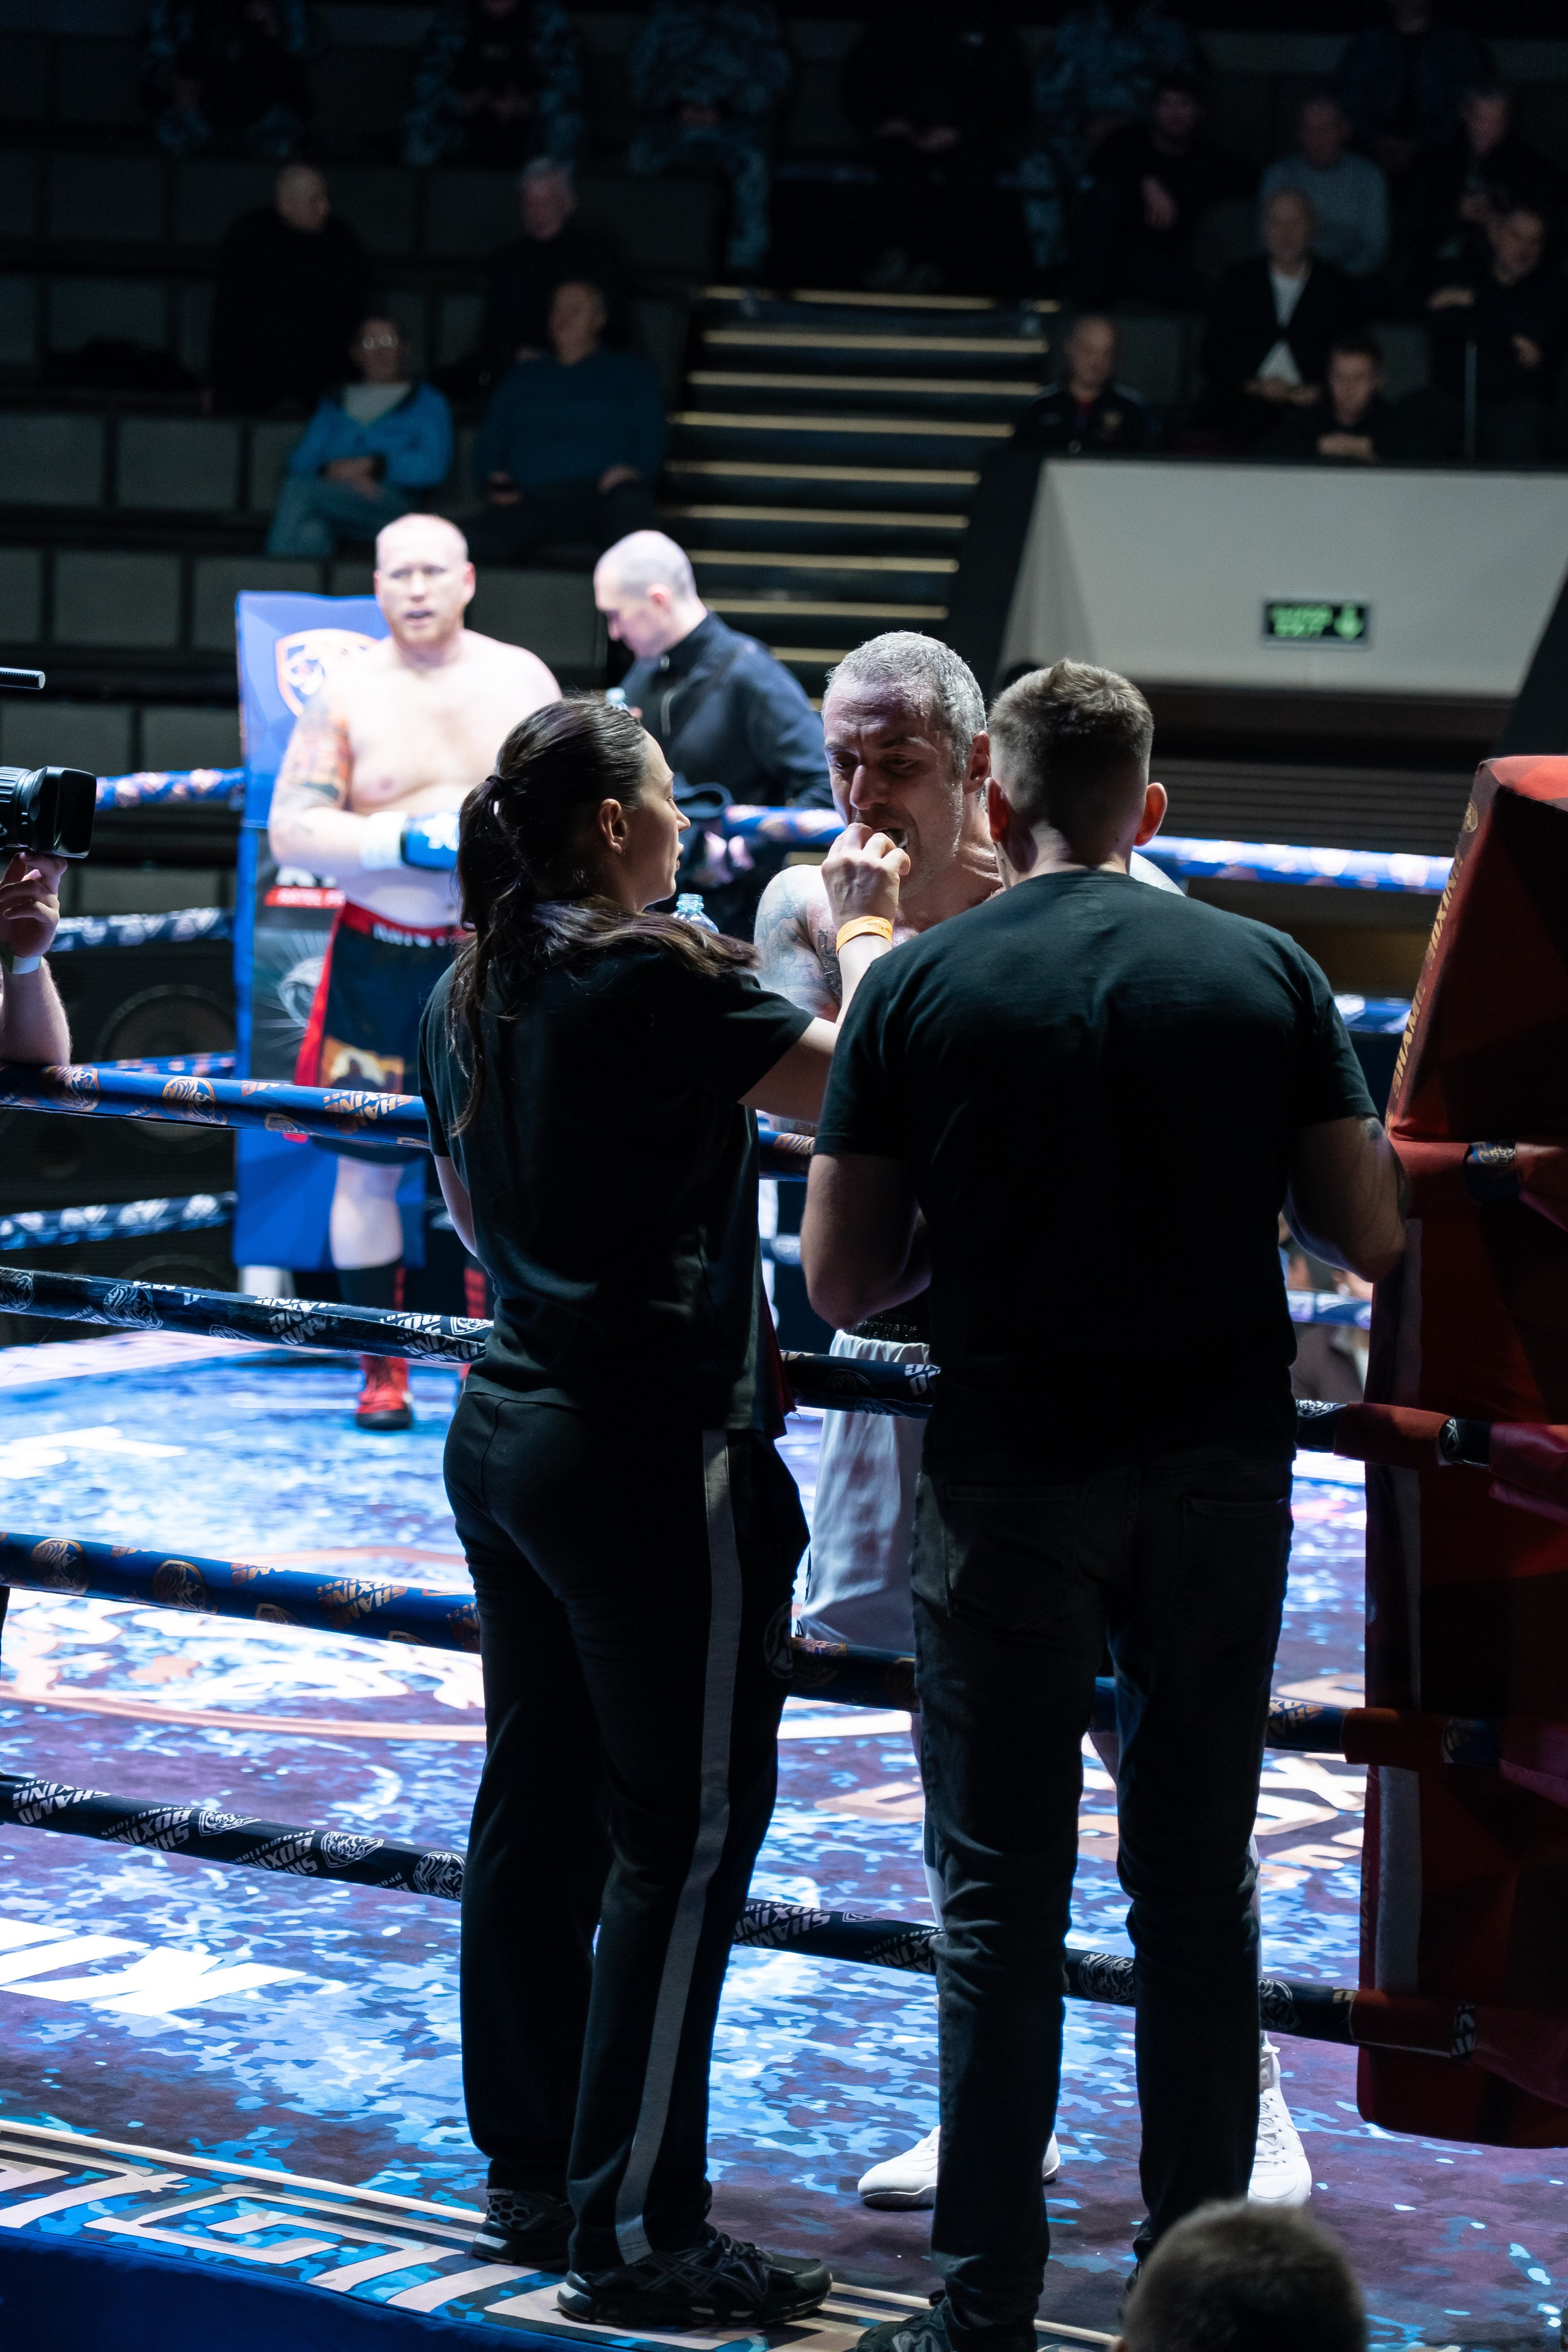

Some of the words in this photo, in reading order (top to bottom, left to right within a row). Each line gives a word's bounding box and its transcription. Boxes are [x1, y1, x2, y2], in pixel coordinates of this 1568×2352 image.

[13, 1783, 81, 1809] XING
[143, 1822, 190, 1850] SHA
[233, 1830, 316, 1863] promotion
[245, 1837, 314, 1871] BOXIN
[734, 1906, 823, 1940] OXIN
